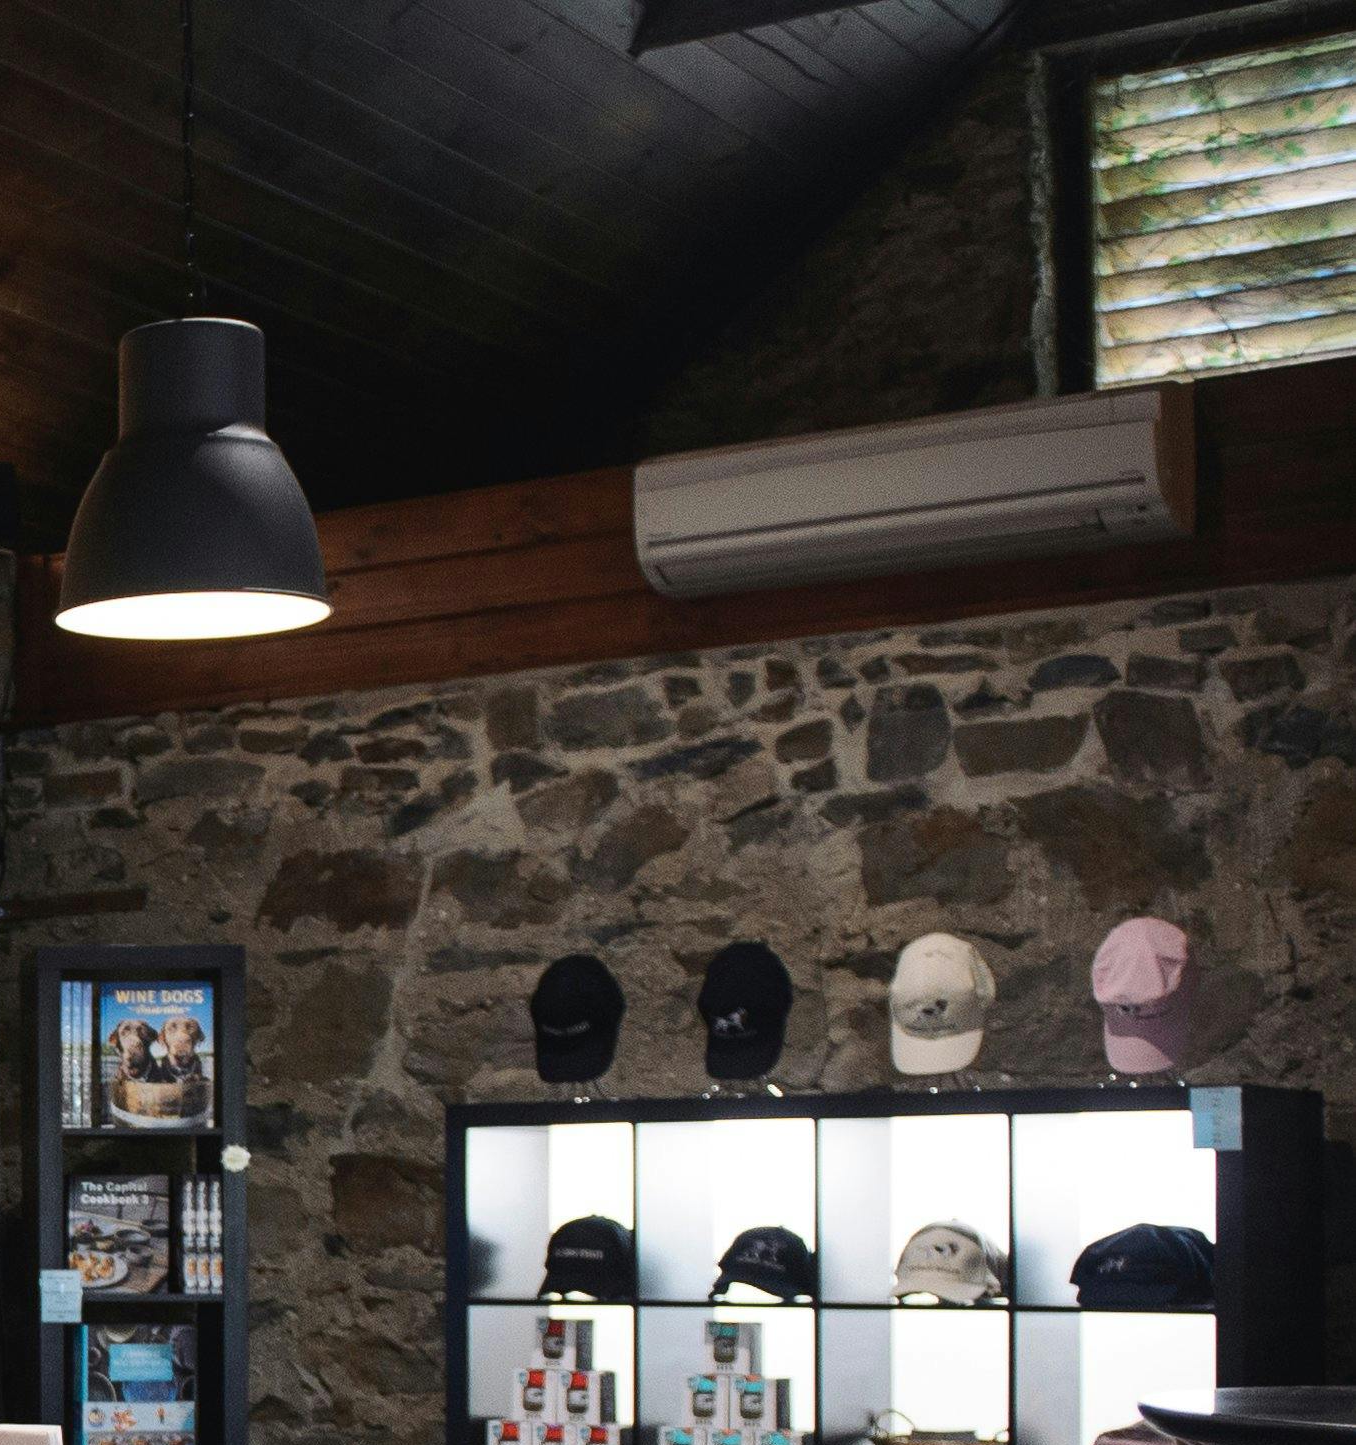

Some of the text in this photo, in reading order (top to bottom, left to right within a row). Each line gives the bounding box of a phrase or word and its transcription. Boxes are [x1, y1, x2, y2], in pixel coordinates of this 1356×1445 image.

[115, 989, 204, 1004] WINE DOGS
[81, 1181, 103, 1191] The
